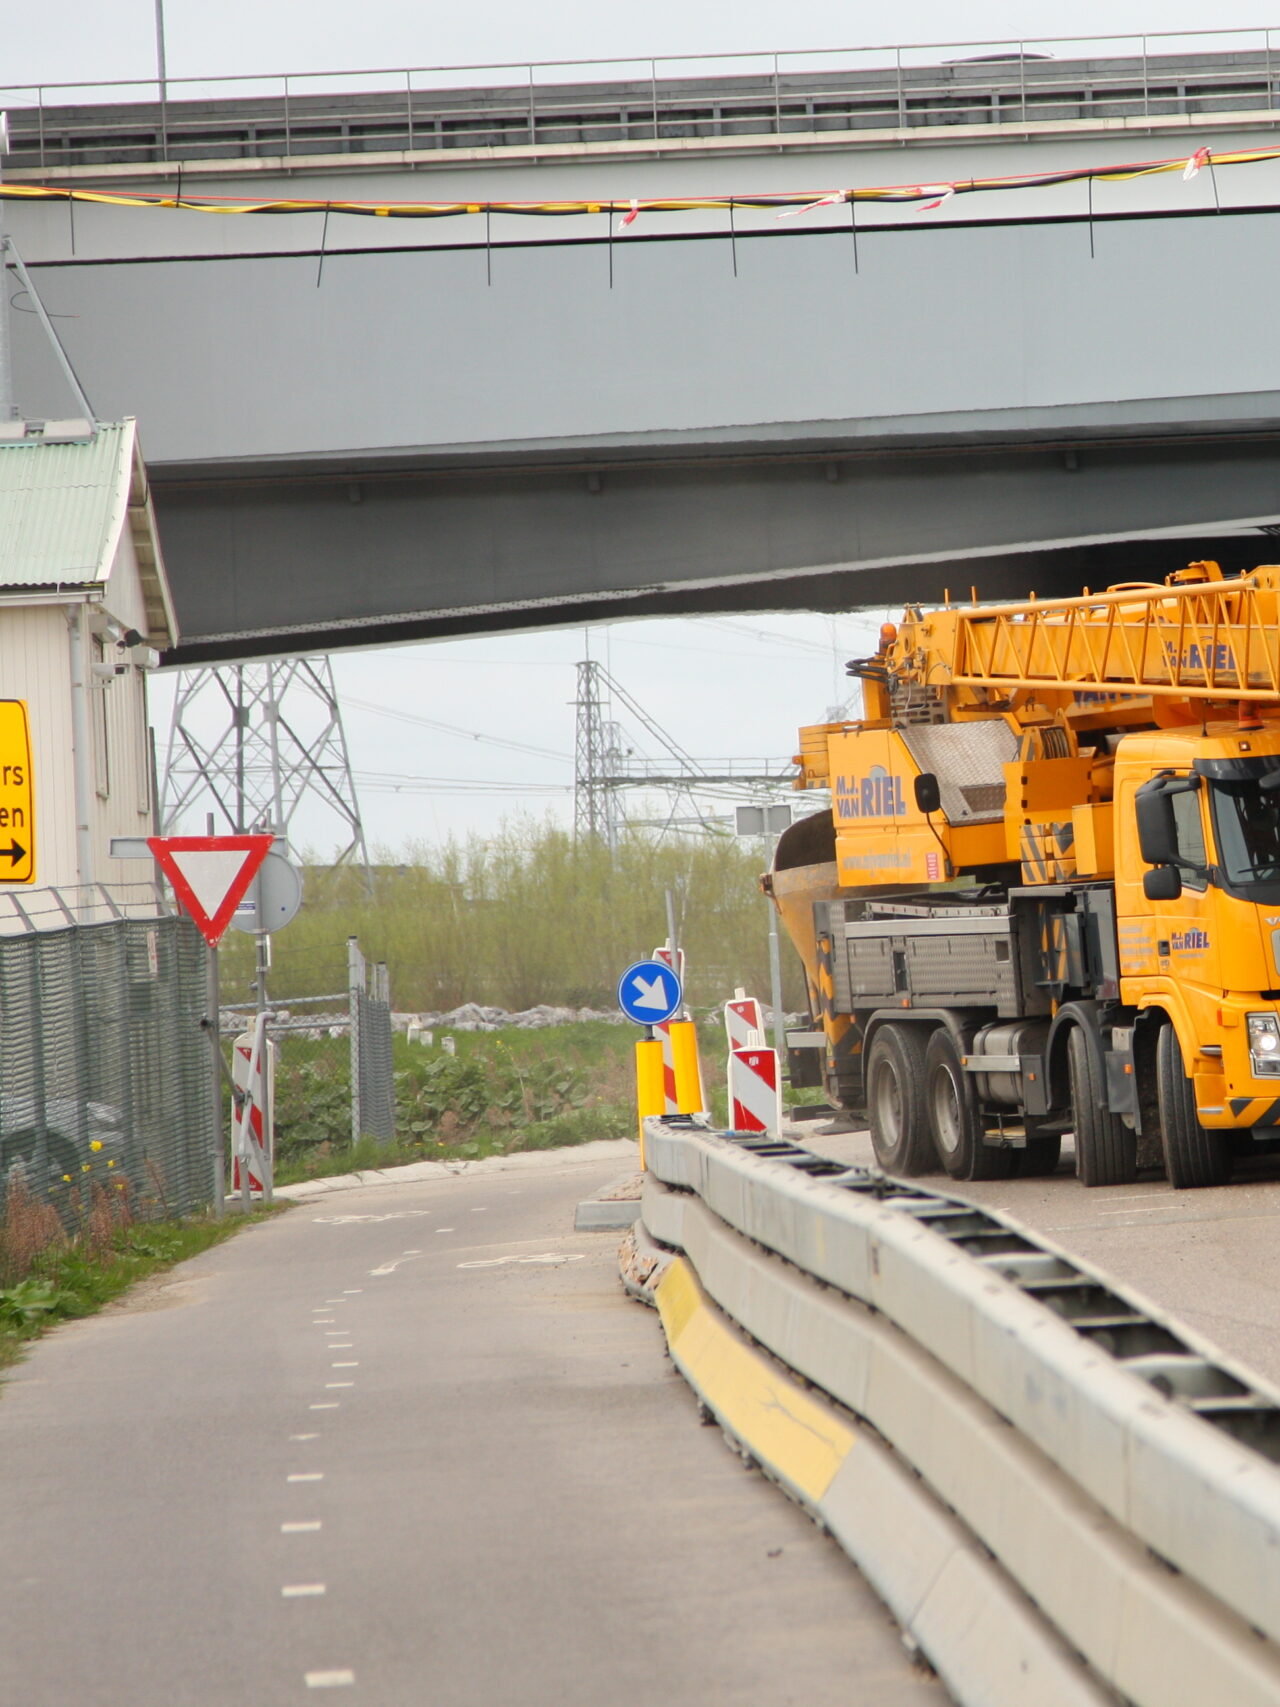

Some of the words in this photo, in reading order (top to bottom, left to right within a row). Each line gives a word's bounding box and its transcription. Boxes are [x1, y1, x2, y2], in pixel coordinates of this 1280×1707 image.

[836, 775, 858, 795] M.J.
[837, 798, 859, 817] VAN
[861, 776, 906, 816] RIEL
[1172, 941, 1184, 950] VAN
[1184, 931, 1210, 949] RIEL
